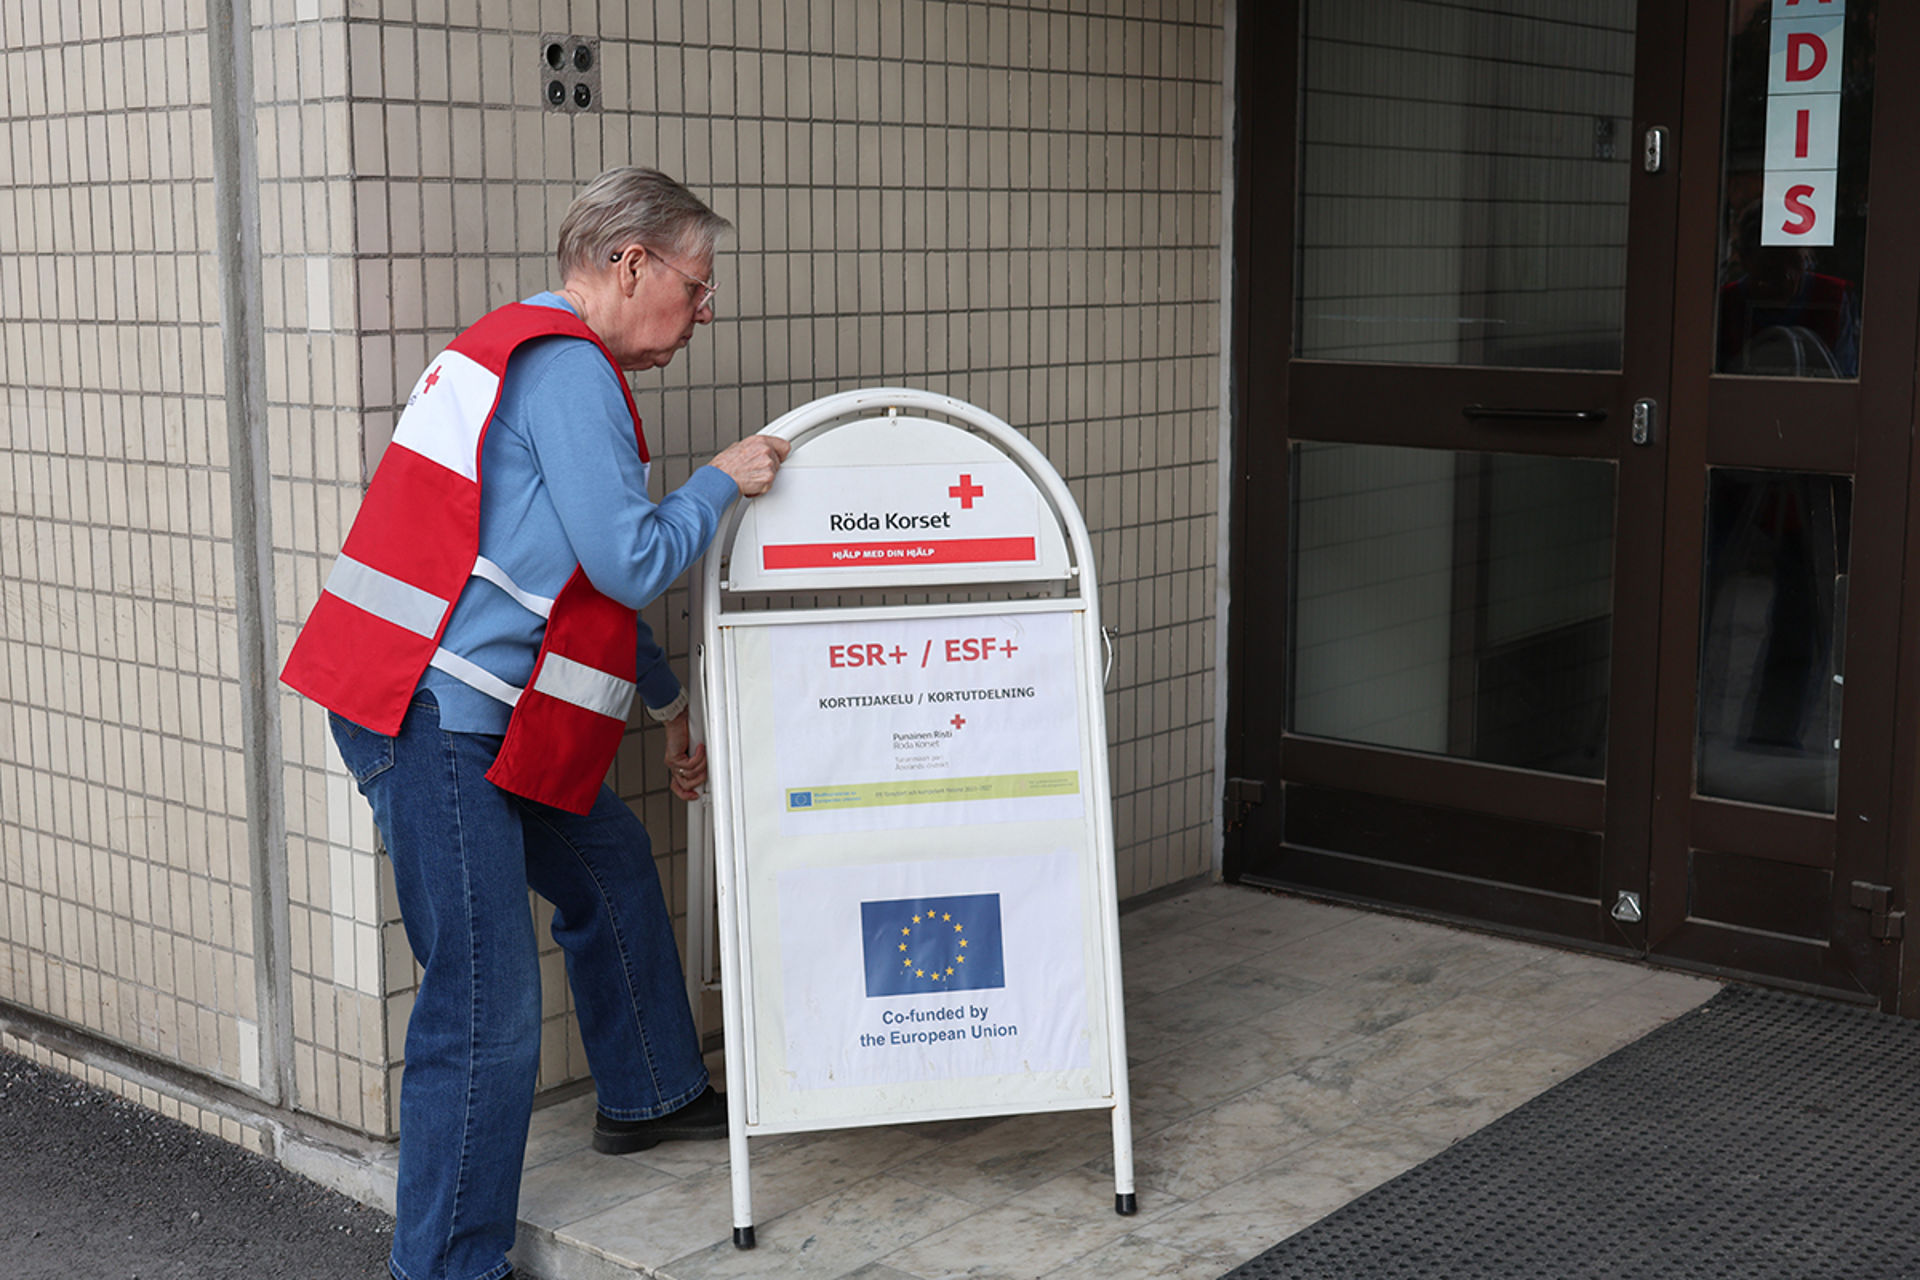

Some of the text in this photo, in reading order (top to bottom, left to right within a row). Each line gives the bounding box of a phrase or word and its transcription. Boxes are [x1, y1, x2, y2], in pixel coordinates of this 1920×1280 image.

[1781, 0, 1832, 235] DIS
[830, 511, 951, 531] Röda Korset
[832, 547, 935, 560] HJÄLP MED DIN HJÄLP
[829, 638, 1018, 668] ESR+ / ESF+
[819, 694, 914, 709] KORTTIJAKELU
[927, 687, 1035, 703] KORTUTDELNING
[882, 1005, 988, 1024] Co-funded by
[860, 1024, 1018, 1047] the European Union
